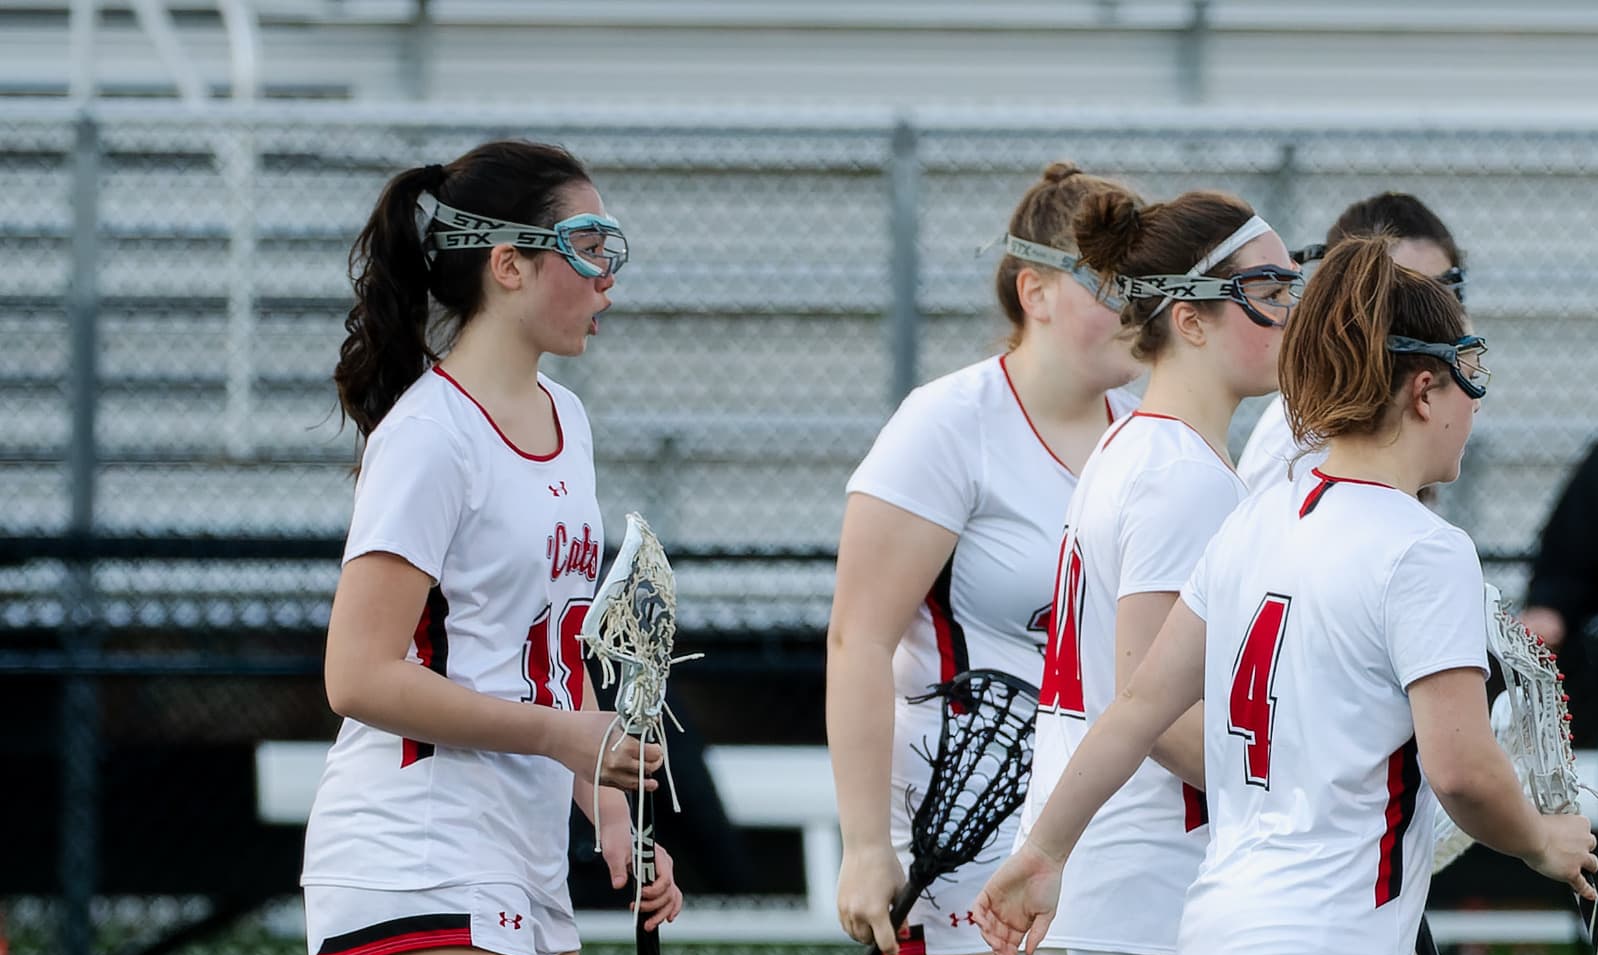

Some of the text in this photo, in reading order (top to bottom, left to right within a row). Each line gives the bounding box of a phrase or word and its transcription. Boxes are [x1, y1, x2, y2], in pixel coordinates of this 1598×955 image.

[446, 232, 492, 246] STX
[516, 231, 559, 246] ST
[1226, 591, 1293, 792] 4
